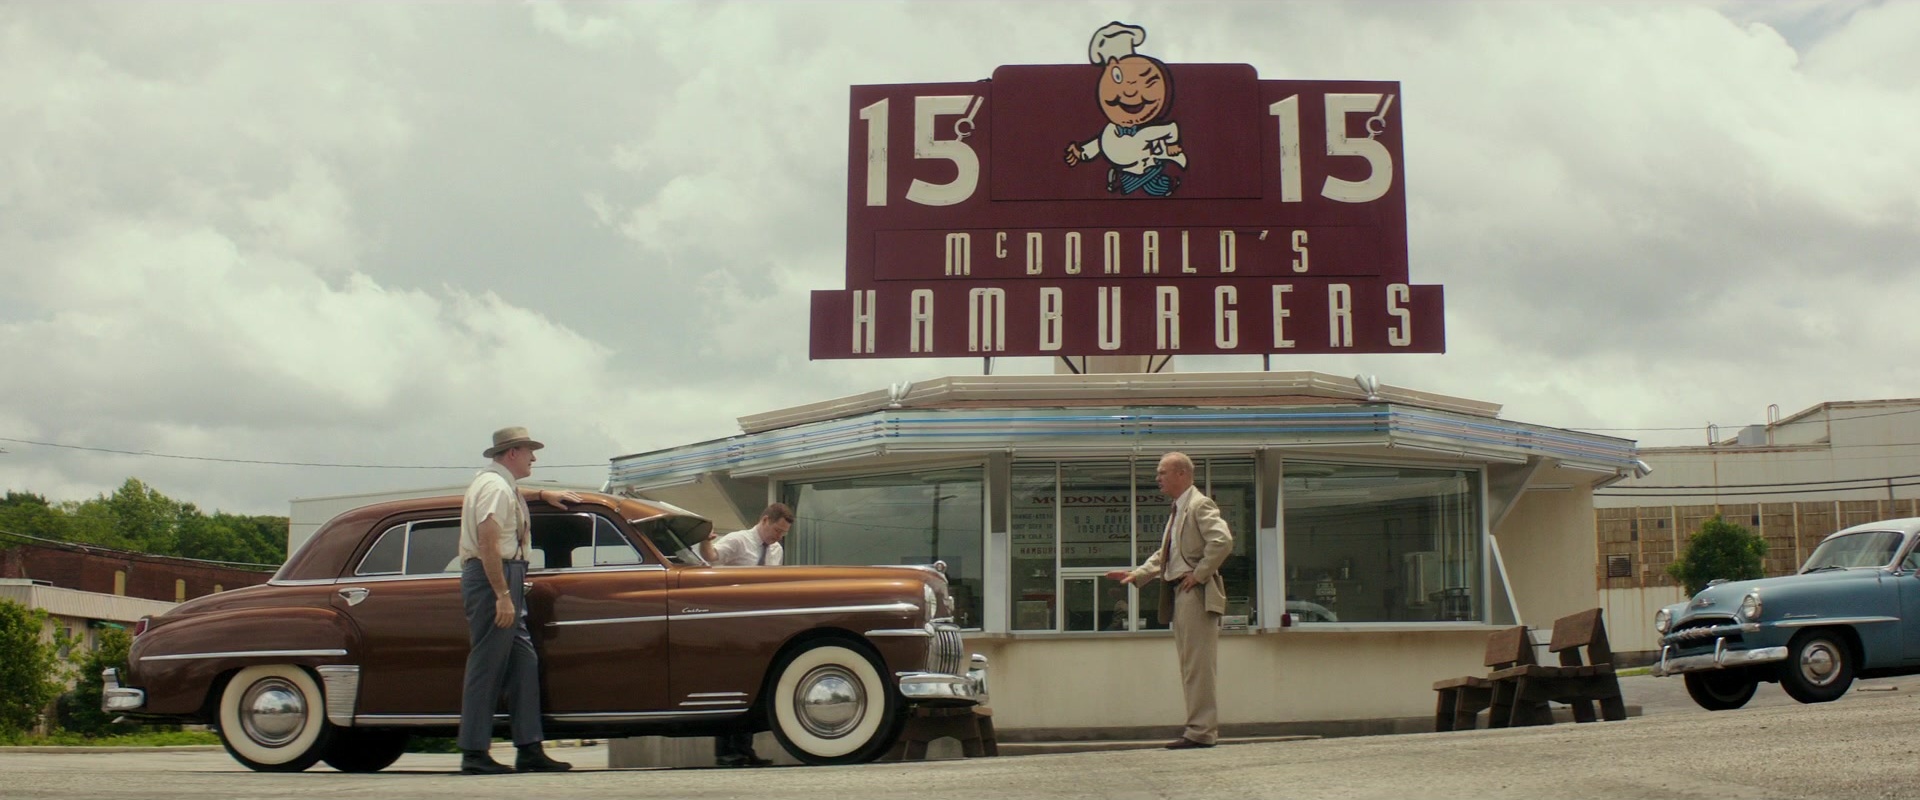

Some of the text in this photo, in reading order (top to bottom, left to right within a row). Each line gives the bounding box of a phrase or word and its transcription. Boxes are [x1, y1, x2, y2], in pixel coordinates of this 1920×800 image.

[852, 283, 1411, 353] HAMBURGERS
[1104, 514, 1169, 524] GOVENMEN
[1077, 524, 1131, 533] INSPECTE
